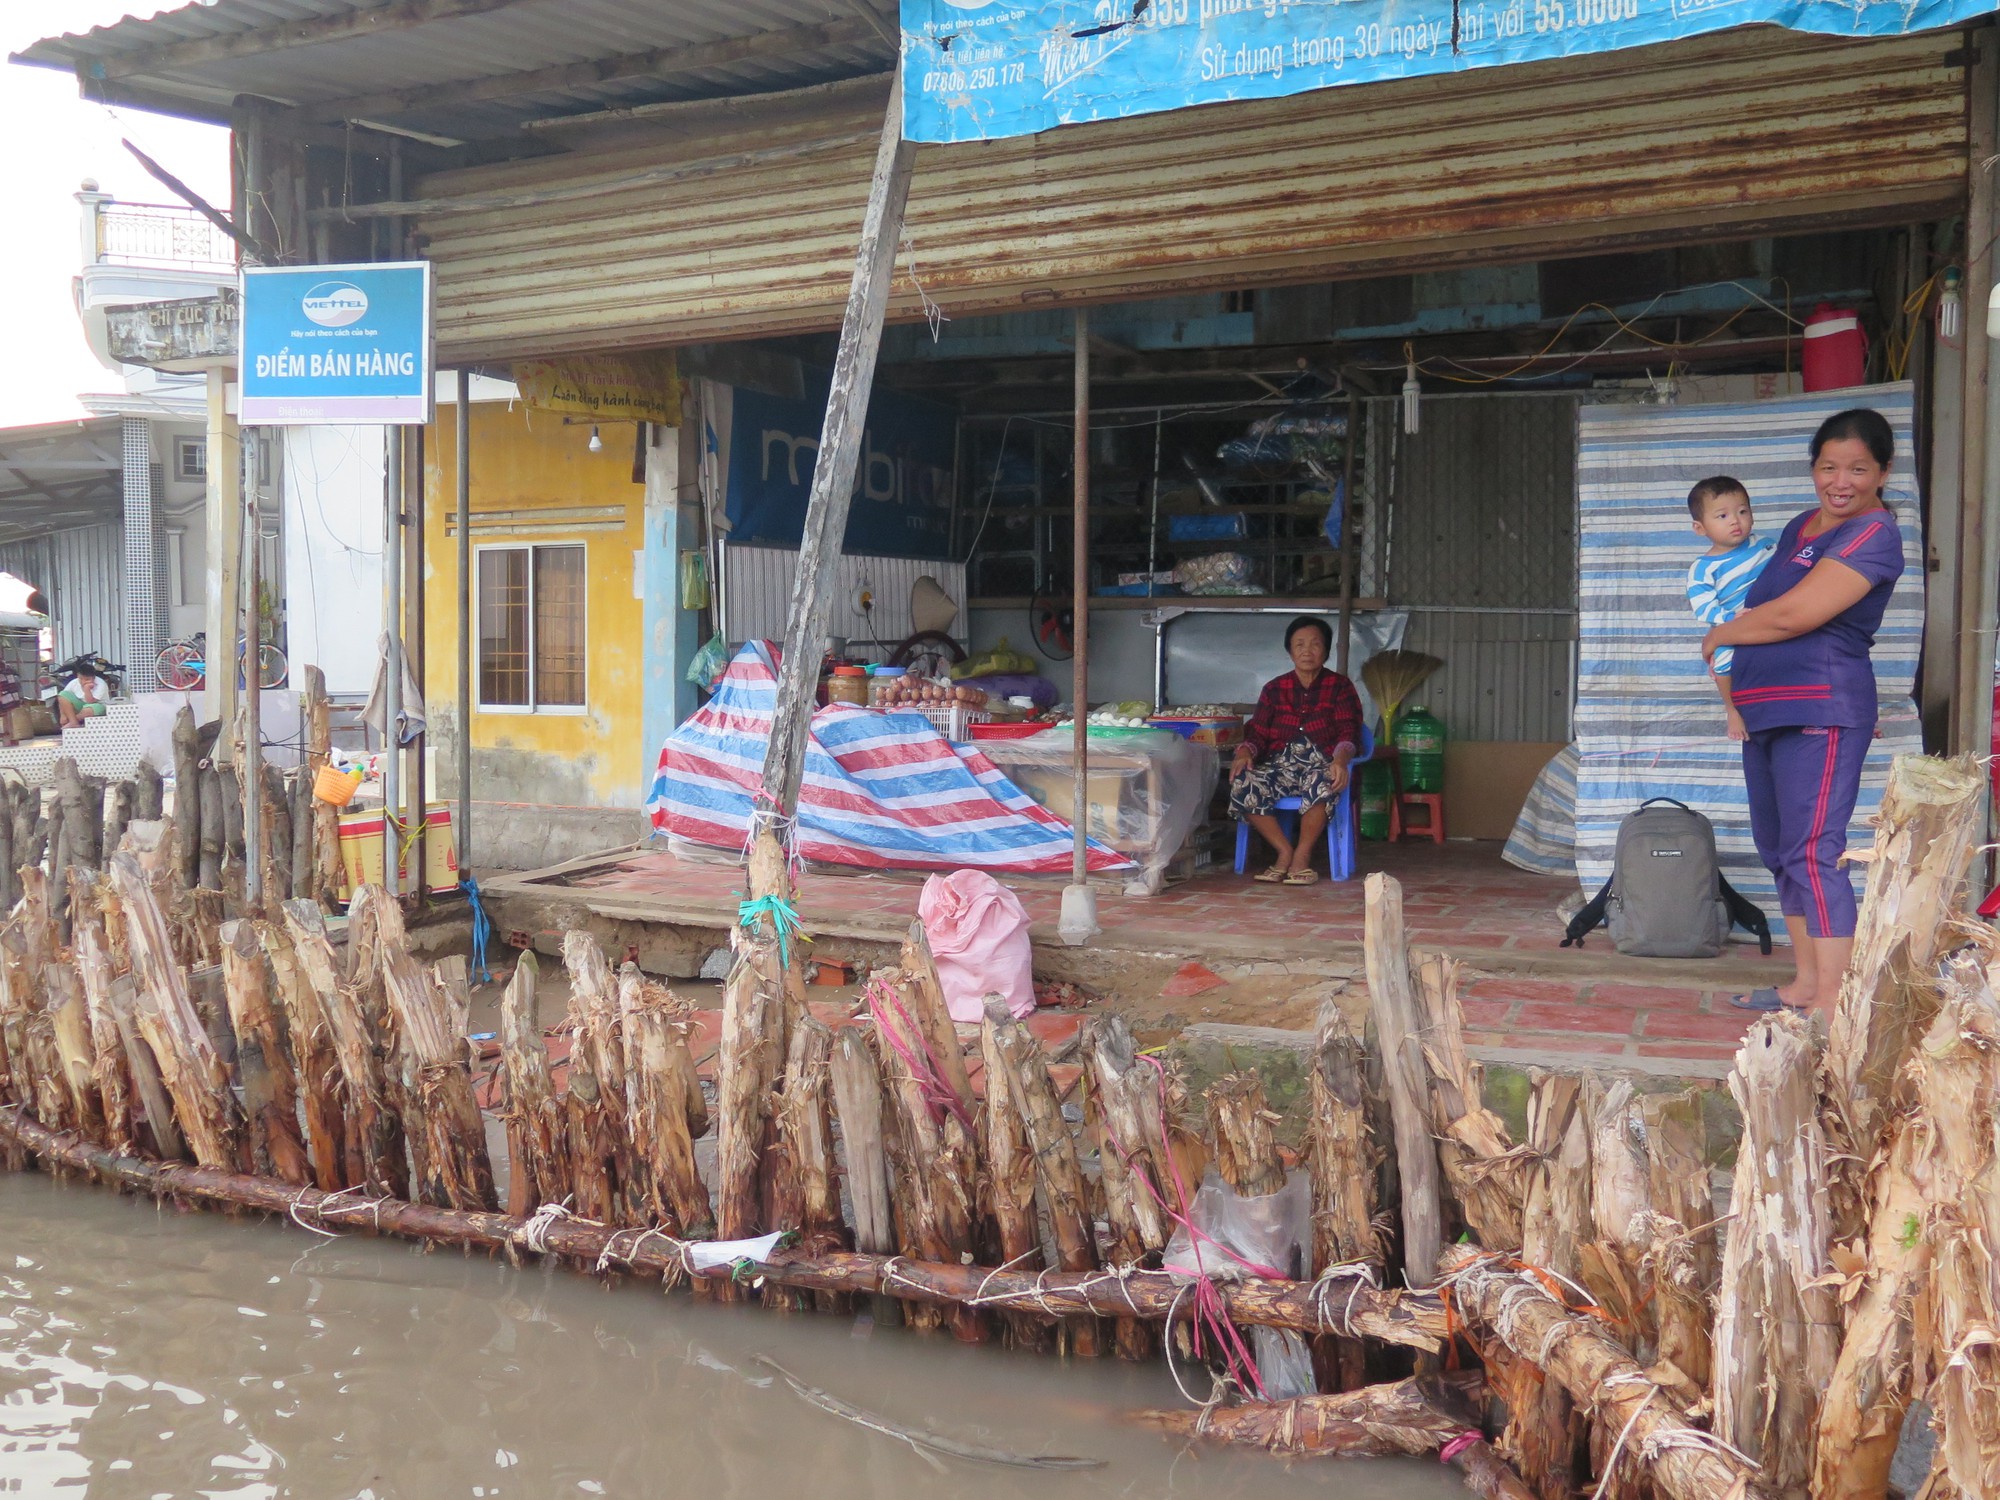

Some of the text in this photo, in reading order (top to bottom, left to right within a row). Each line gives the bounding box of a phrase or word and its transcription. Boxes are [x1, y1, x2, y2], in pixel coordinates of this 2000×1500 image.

[976, 15, 995, 27] cách
[1010, 9, 1026, 22] bạn
[1201, 14, 1442, 81] Sử dụng trong 30 ngày
[303, 299, 366, 309] VIETTEL
[317, 329, 333, 337] theo
[364, 328, 378, 338] bạn
[255, 346, 414, 378] ĐIỂM BÁN HÀNG
[602, 391, 631, 407] hành
